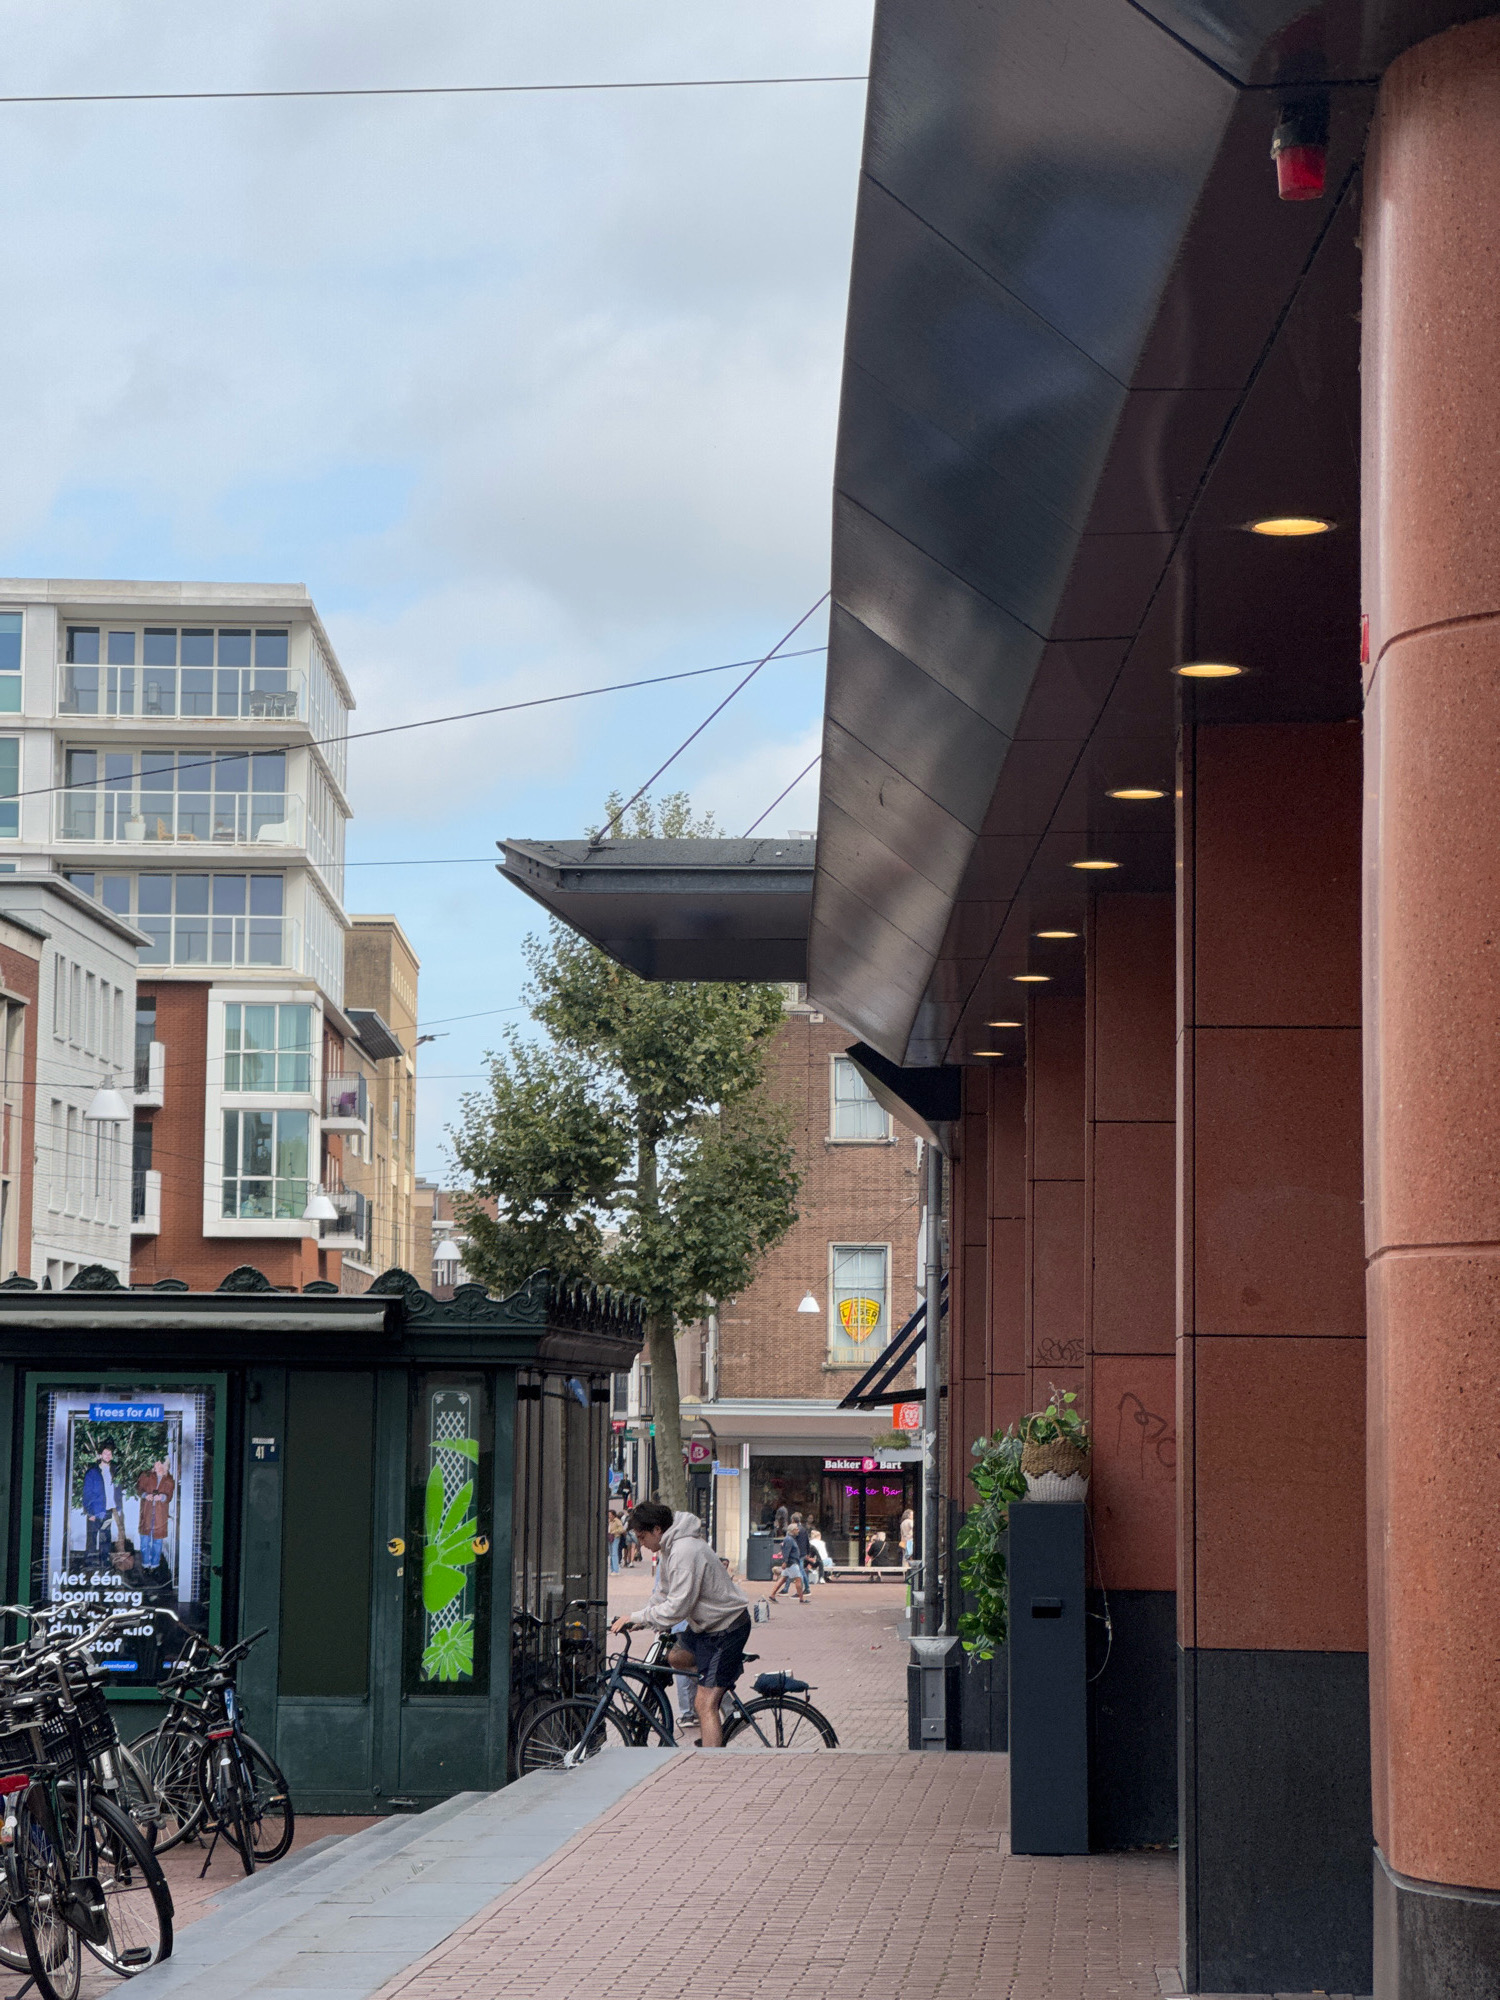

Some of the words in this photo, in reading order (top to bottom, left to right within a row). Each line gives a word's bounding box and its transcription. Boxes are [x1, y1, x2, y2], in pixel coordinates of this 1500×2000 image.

[93, 1407, 124, 1417] Trees
[126, 1407, 143, 1417] for
[144, 1407, 160, 1418] All
[255, 1445, 265, 1460] 41
[824, 1460, 861, 1469] Bakker
[879, 1461, 902, 1470] Bart
[52, 1571, 87, 1586] Met
[90, 1570, 122, 1586] één
[51, 1588, 100, 1603] boom
[103, 1590, 143, 1607] zorg
